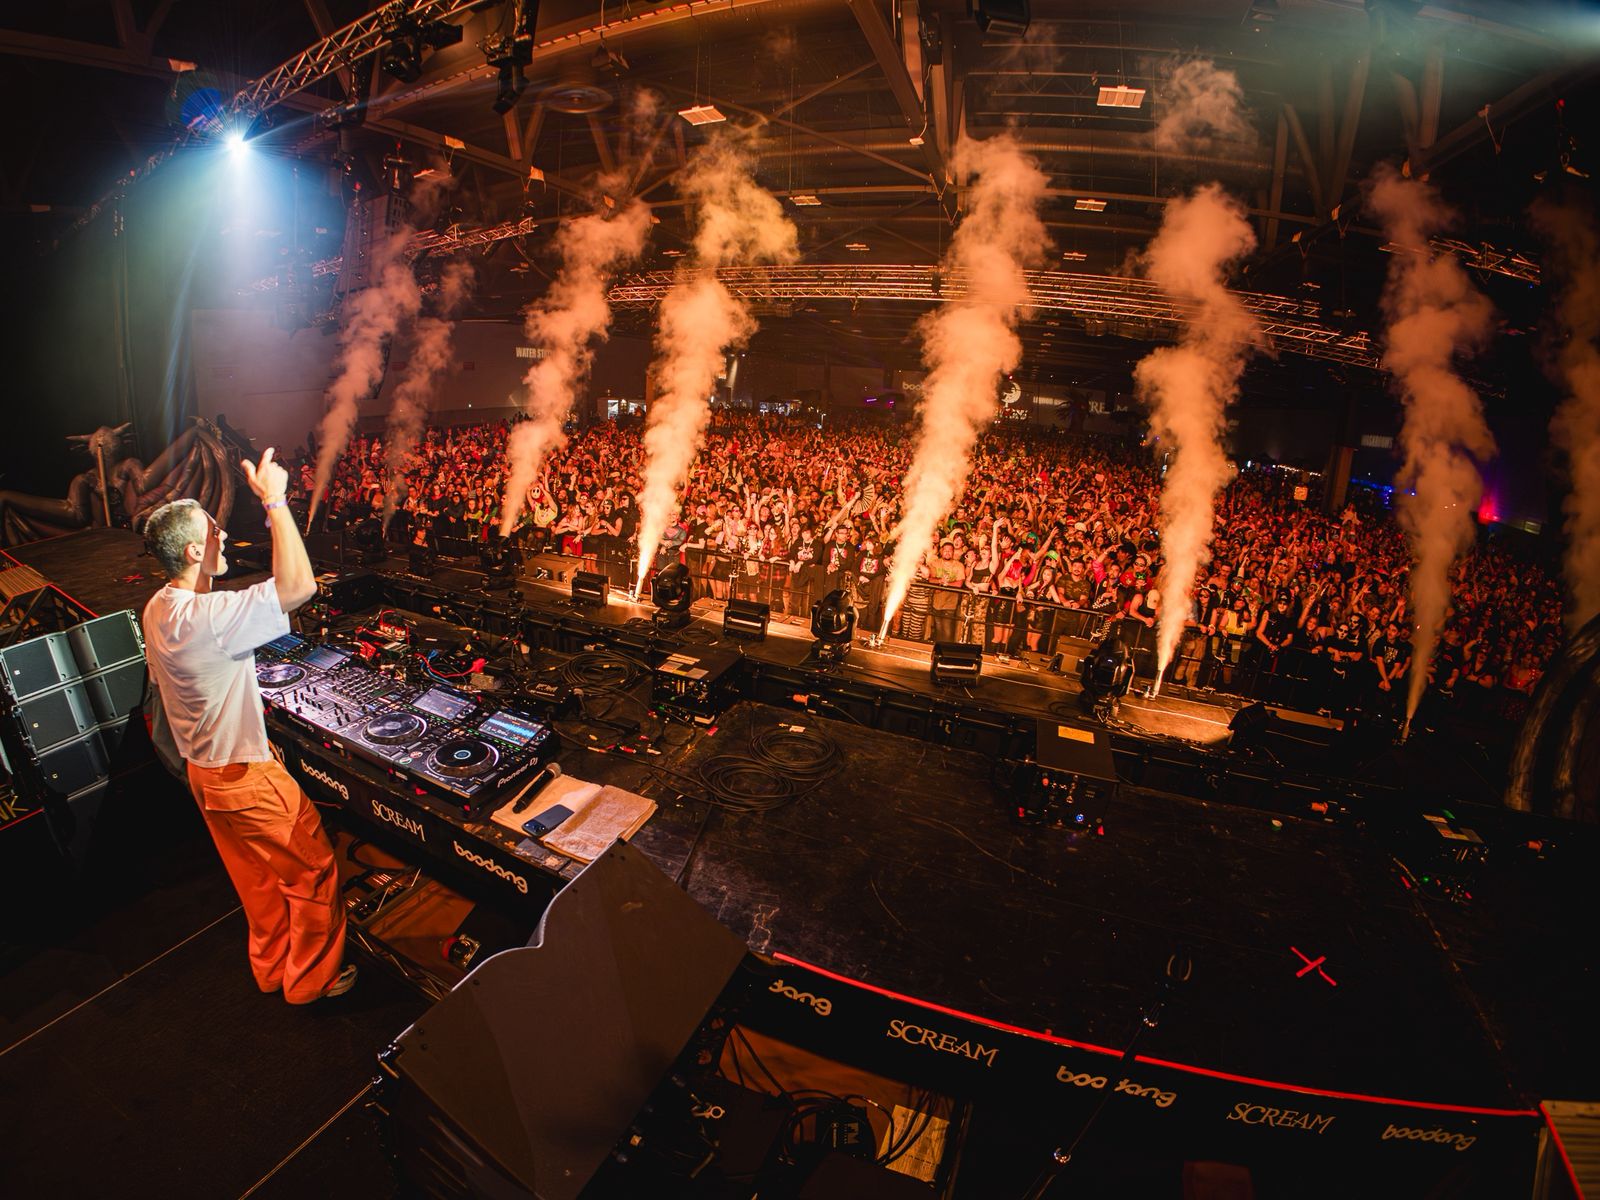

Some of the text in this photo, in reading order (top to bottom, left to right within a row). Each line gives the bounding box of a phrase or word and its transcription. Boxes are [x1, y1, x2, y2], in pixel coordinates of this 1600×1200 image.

[515, 347, 537, 358] WATER
[300, 758, 350, 801] boodang
[497, 757, 539, 788] Pioneer DJ
[371, 799, 426, 842] SCREAM
[453, 840, 528, 894] boodang
[886, 1019, 999, 1068] SCREAM
[1226, 1102, 1336, 1135] SCREAM
[1381, 1124, 1477, 1151] boodang
